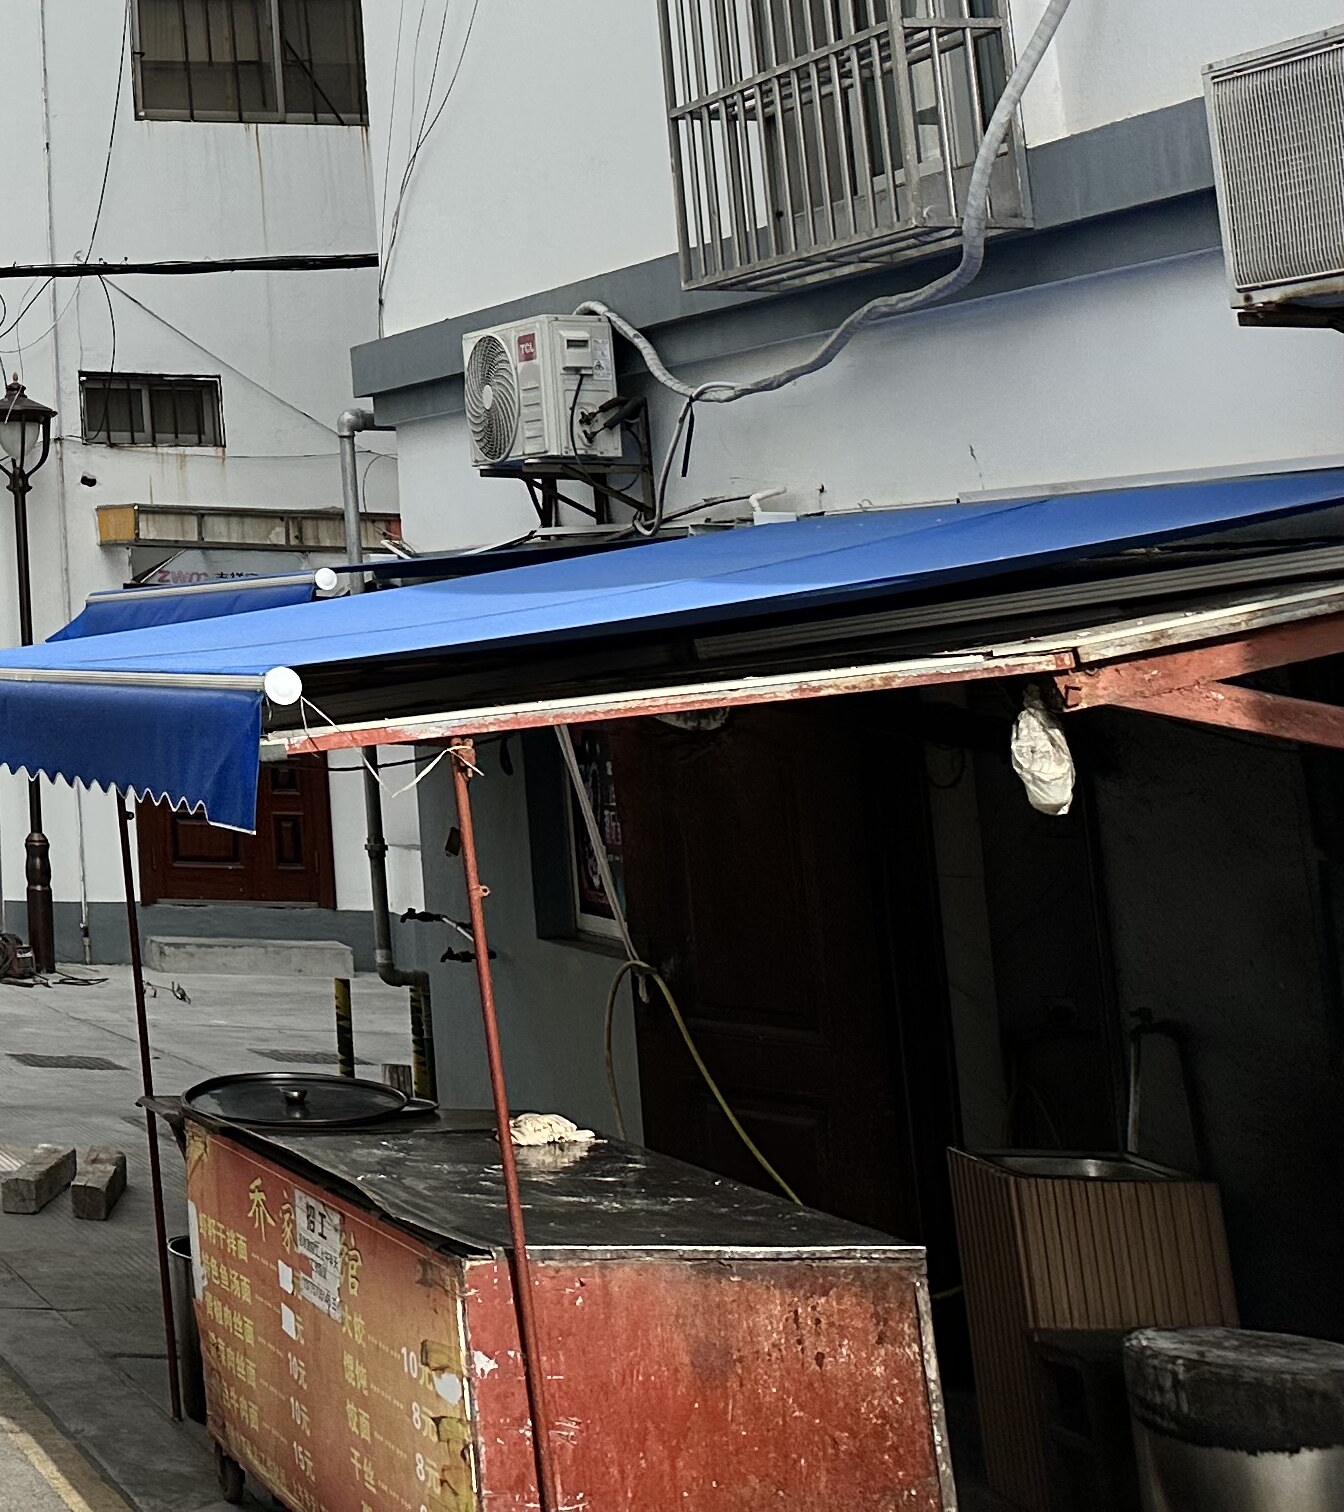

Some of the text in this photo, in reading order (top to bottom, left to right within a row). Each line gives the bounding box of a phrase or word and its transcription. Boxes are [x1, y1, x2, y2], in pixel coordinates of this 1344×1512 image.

[519, 342, 535, 355] TCL
[247, 1177, 363, 1297] 乔家馆
[293, 1441, 315, 1483] 15元
